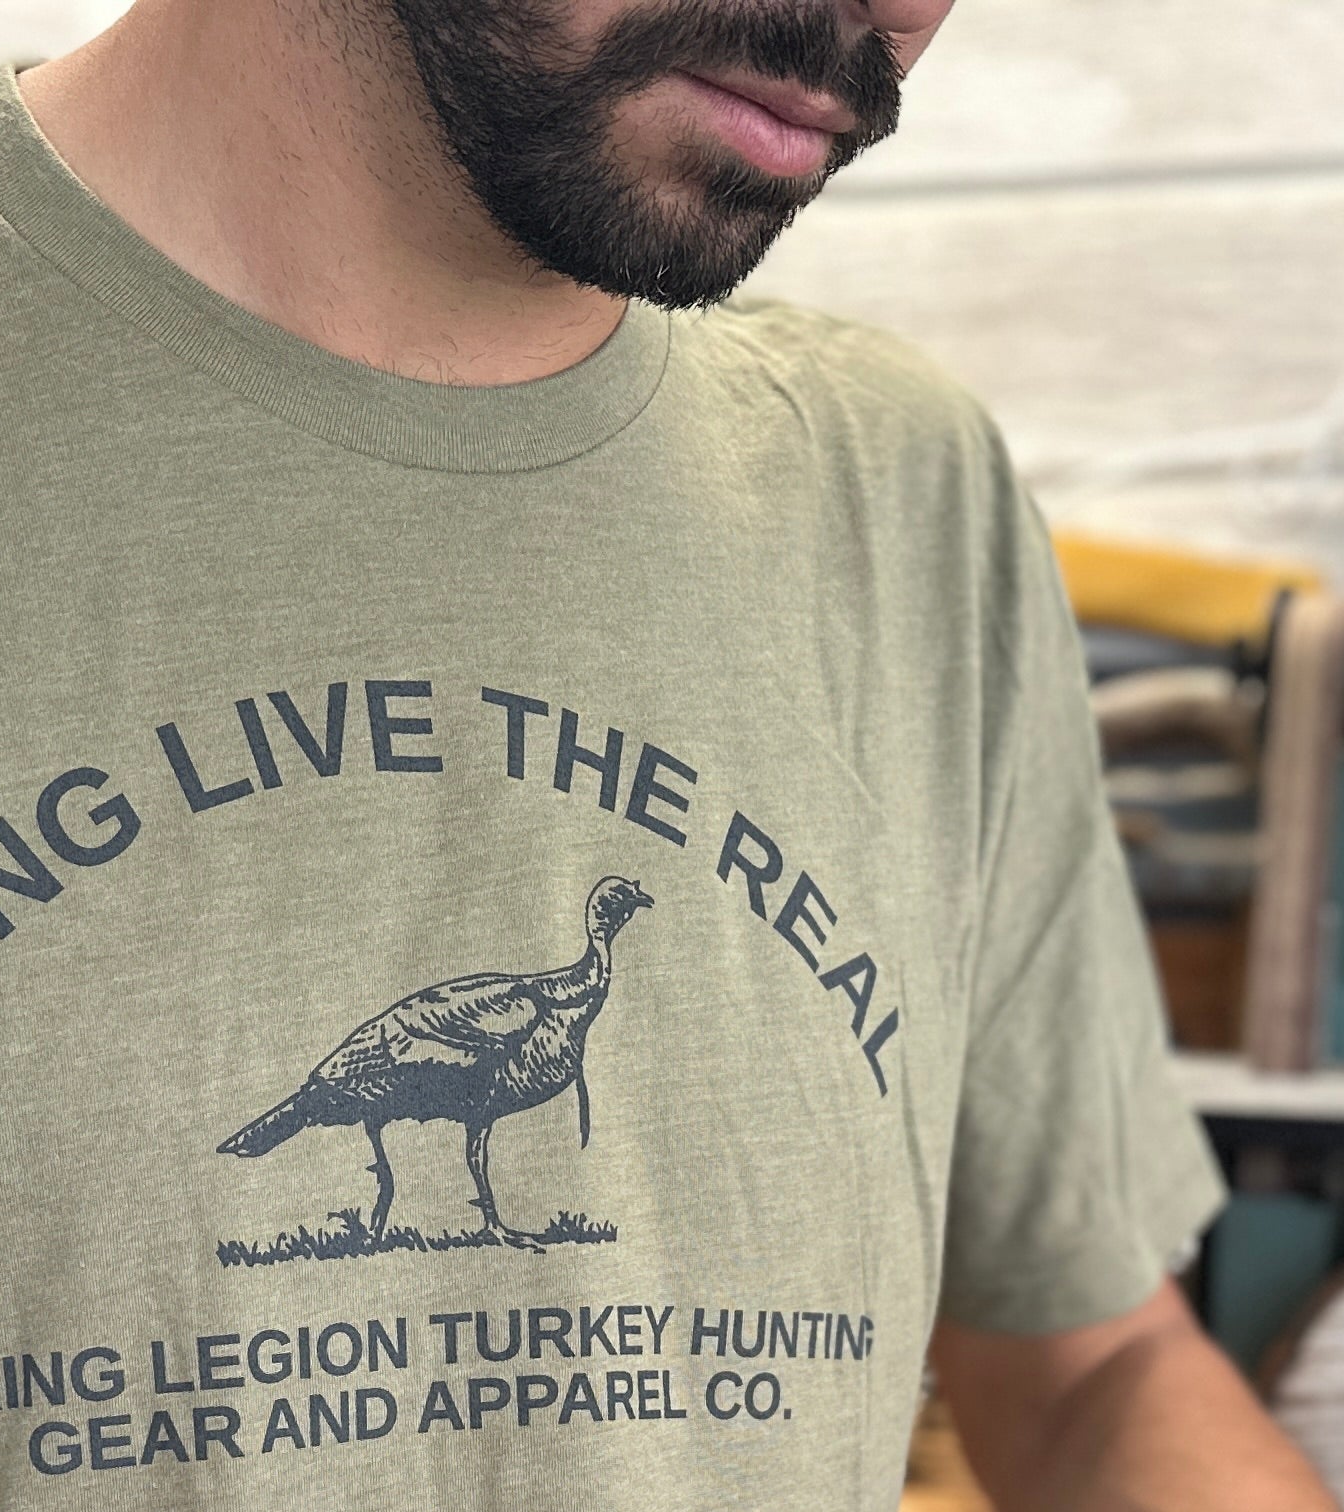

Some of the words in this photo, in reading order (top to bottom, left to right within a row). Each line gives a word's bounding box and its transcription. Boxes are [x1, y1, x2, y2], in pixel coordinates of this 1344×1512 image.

[155, 679, 445, 813] LIVE
[480, 686, 699, 847] THE
[715, 810, 900, 1099] REAL
[150, 1317, 409, 1396] LEGION
[428, 1305, 675, 1366] TURKEY
[27, 1405, 243, 1477] GEAR
[261, 1386, 399, 1454] AND
[418, 1370, 687, 1434] APPAREL
[705, 1370, 792, 1420] CO.
